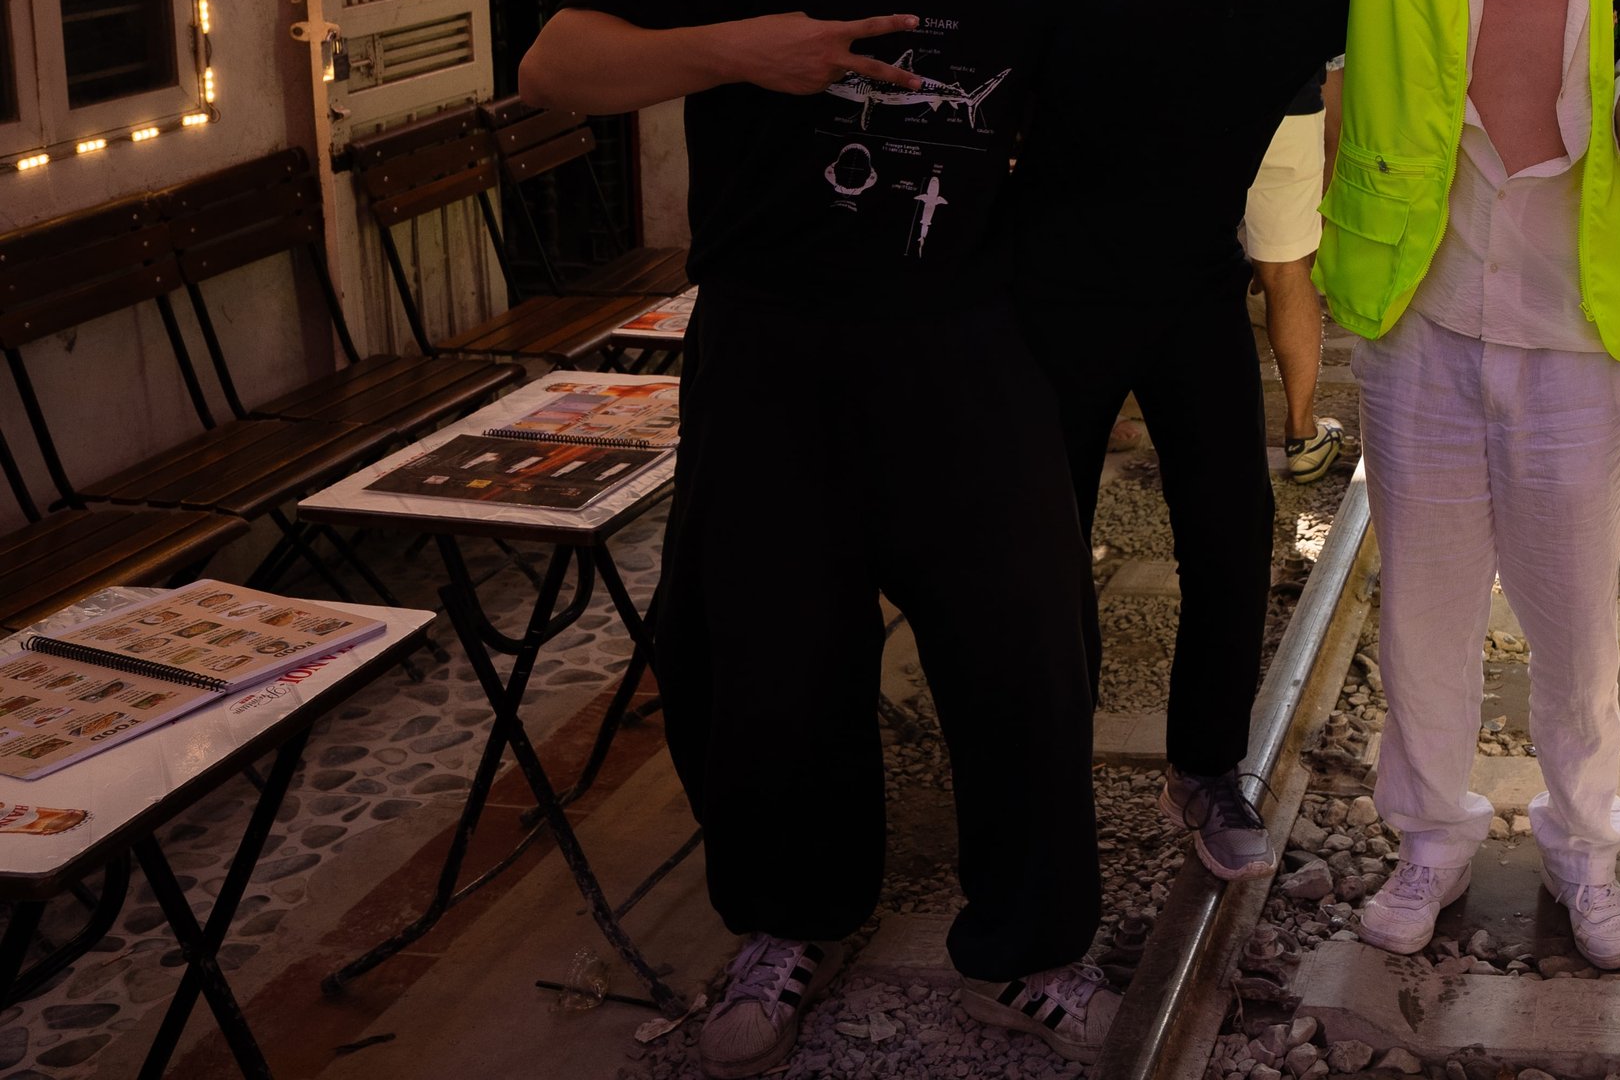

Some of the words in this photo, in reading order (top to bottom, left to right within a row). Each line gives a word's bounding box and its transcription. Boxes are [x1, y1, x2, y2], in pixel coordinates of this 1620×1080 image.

[924, 17, 959, 31] SHARK
[274, 641, 317, 658] FOOD
[90, 718, 141, 742] FOOD
